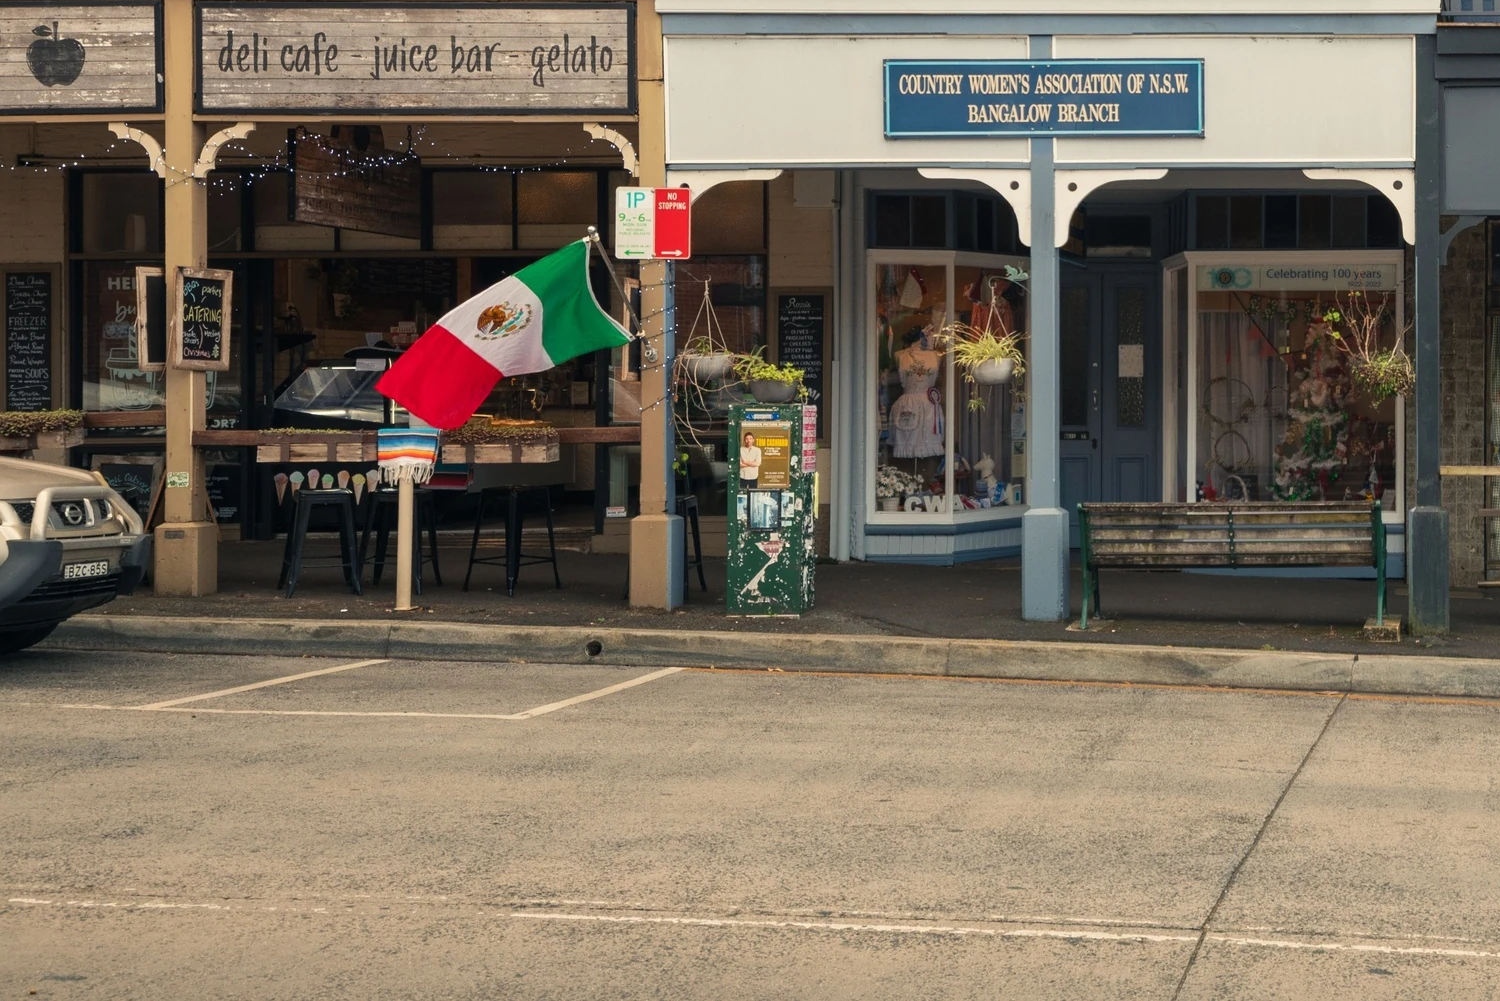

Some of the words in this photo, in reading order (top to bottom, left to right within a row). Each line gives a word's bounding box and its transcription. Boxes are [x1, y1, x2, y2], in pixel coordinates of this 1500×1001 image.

[218, 30, 268, 73] deli
[280, 32, 338, 76] cafe
[370, 36, 438, 80] juice
[450, 35, 501, 74] bar
[531, 33, 613, 88] gelato
[899, 74, 963, 95] COUNTRY
[968, 74, 1029, 95] WOMEN'S
[1034, 73, 1122, 94] ASSOCIATION
[1127, 73, 1145, 94] OF
[1149, 73, 1189, 94] N.S.W.
[968, 104, 1052, 123] BANGALOW
[1057, 103, 1120, 123] BRANCH
[626, 191, 646, 208] 1P
[667, 192, 677, 200] NO
[658, 202, 687, 210] STOPPING
[1266, 268, 1329, 281] Celebrating
[1332, 269, 1350, 278] 100
[1353, 270, 1382, 281] years
[8, 316, 47, 326] FREEZER
[183, 303, 222, 327] CATERING
[25, 368, 49, 379] SOUPS
[904, 494, 965, 513] CWA
